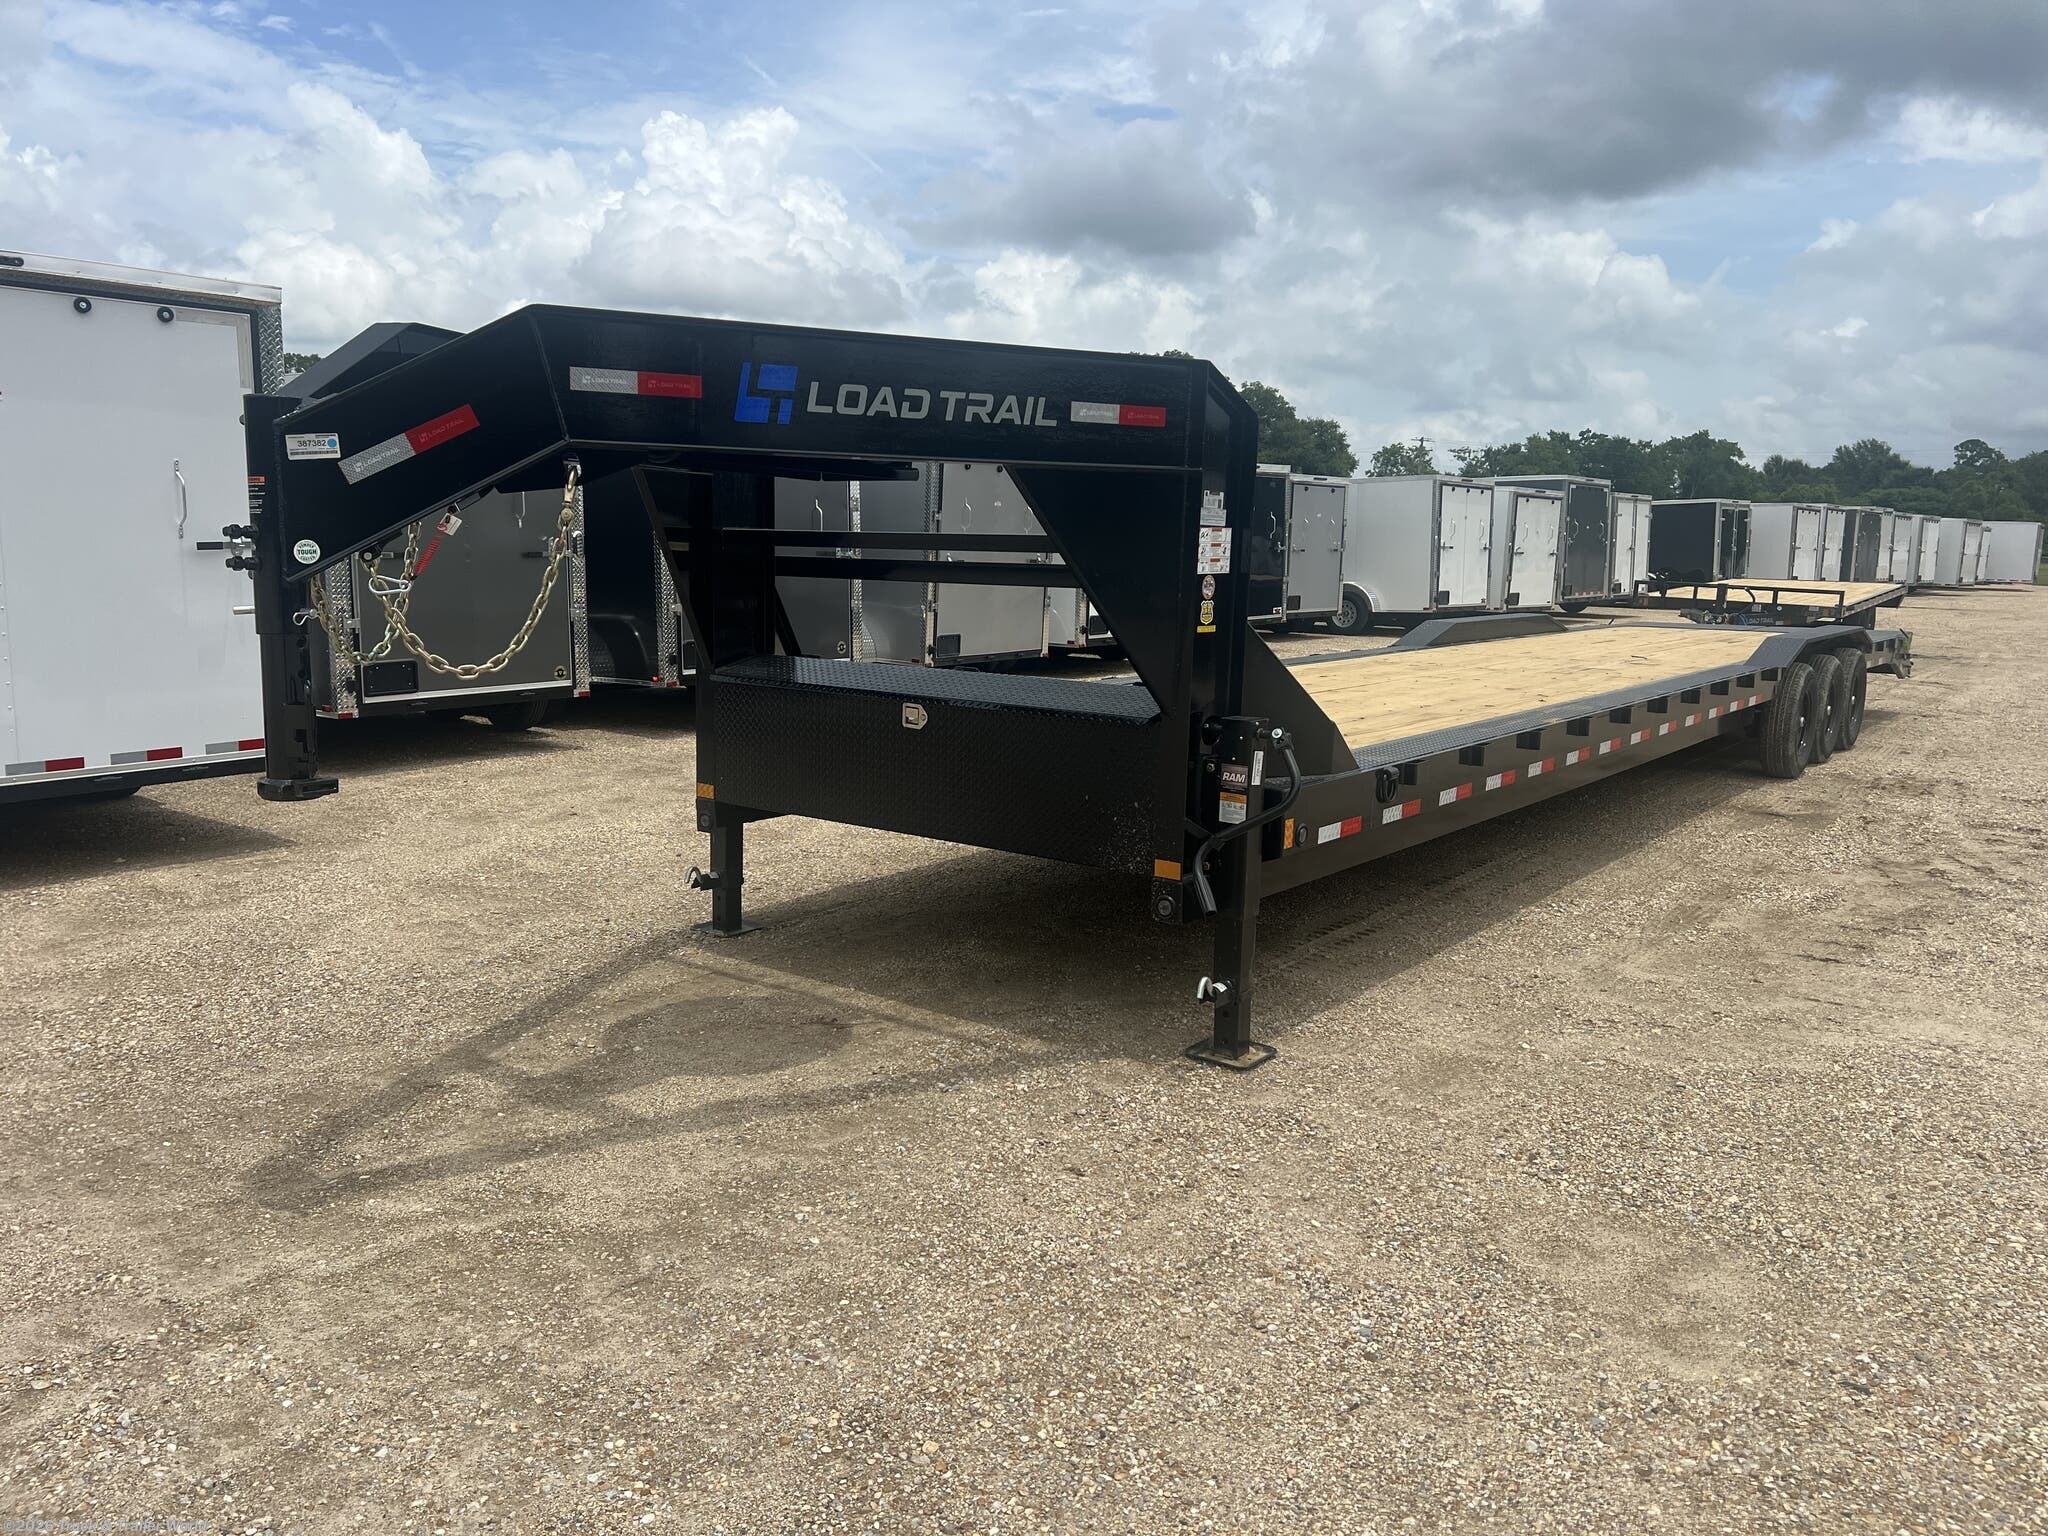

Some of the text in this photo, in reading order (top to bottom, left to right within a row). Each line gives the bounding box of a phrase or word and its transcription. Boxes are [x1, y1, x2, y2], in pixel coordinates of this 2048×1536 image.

[807, 381, 1058, 427] LOAD TRAIL
[297, 440, 327, 448] 387382
[1222, 772, 1246, 783] RAM
